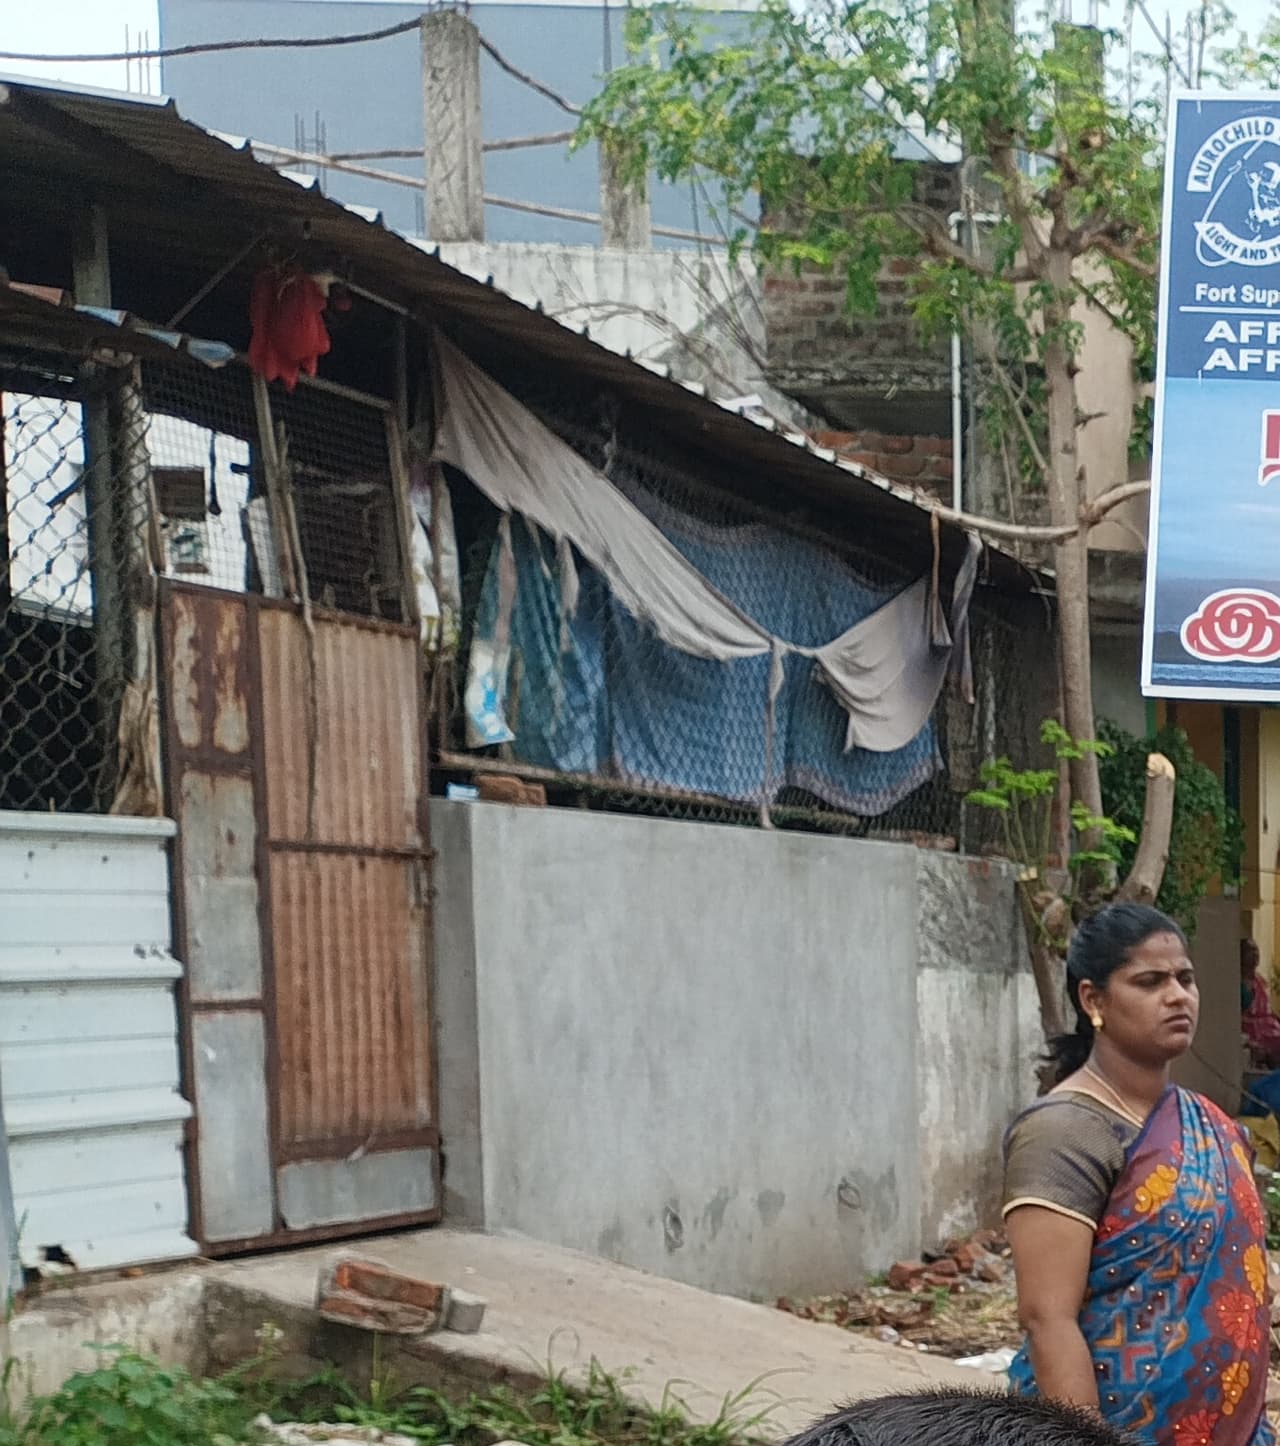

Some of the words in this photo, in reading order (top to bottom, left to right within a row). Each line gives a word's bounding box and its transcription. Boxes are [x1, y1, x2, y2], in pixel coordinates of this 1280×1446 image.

[1193, 120, 1275, 186] AUROCHILD
[1205, 226, 1238, 255] LIGHT
[1240, 247, 1267, 260] AND
[1195, 283, 1236, 303] Fort
